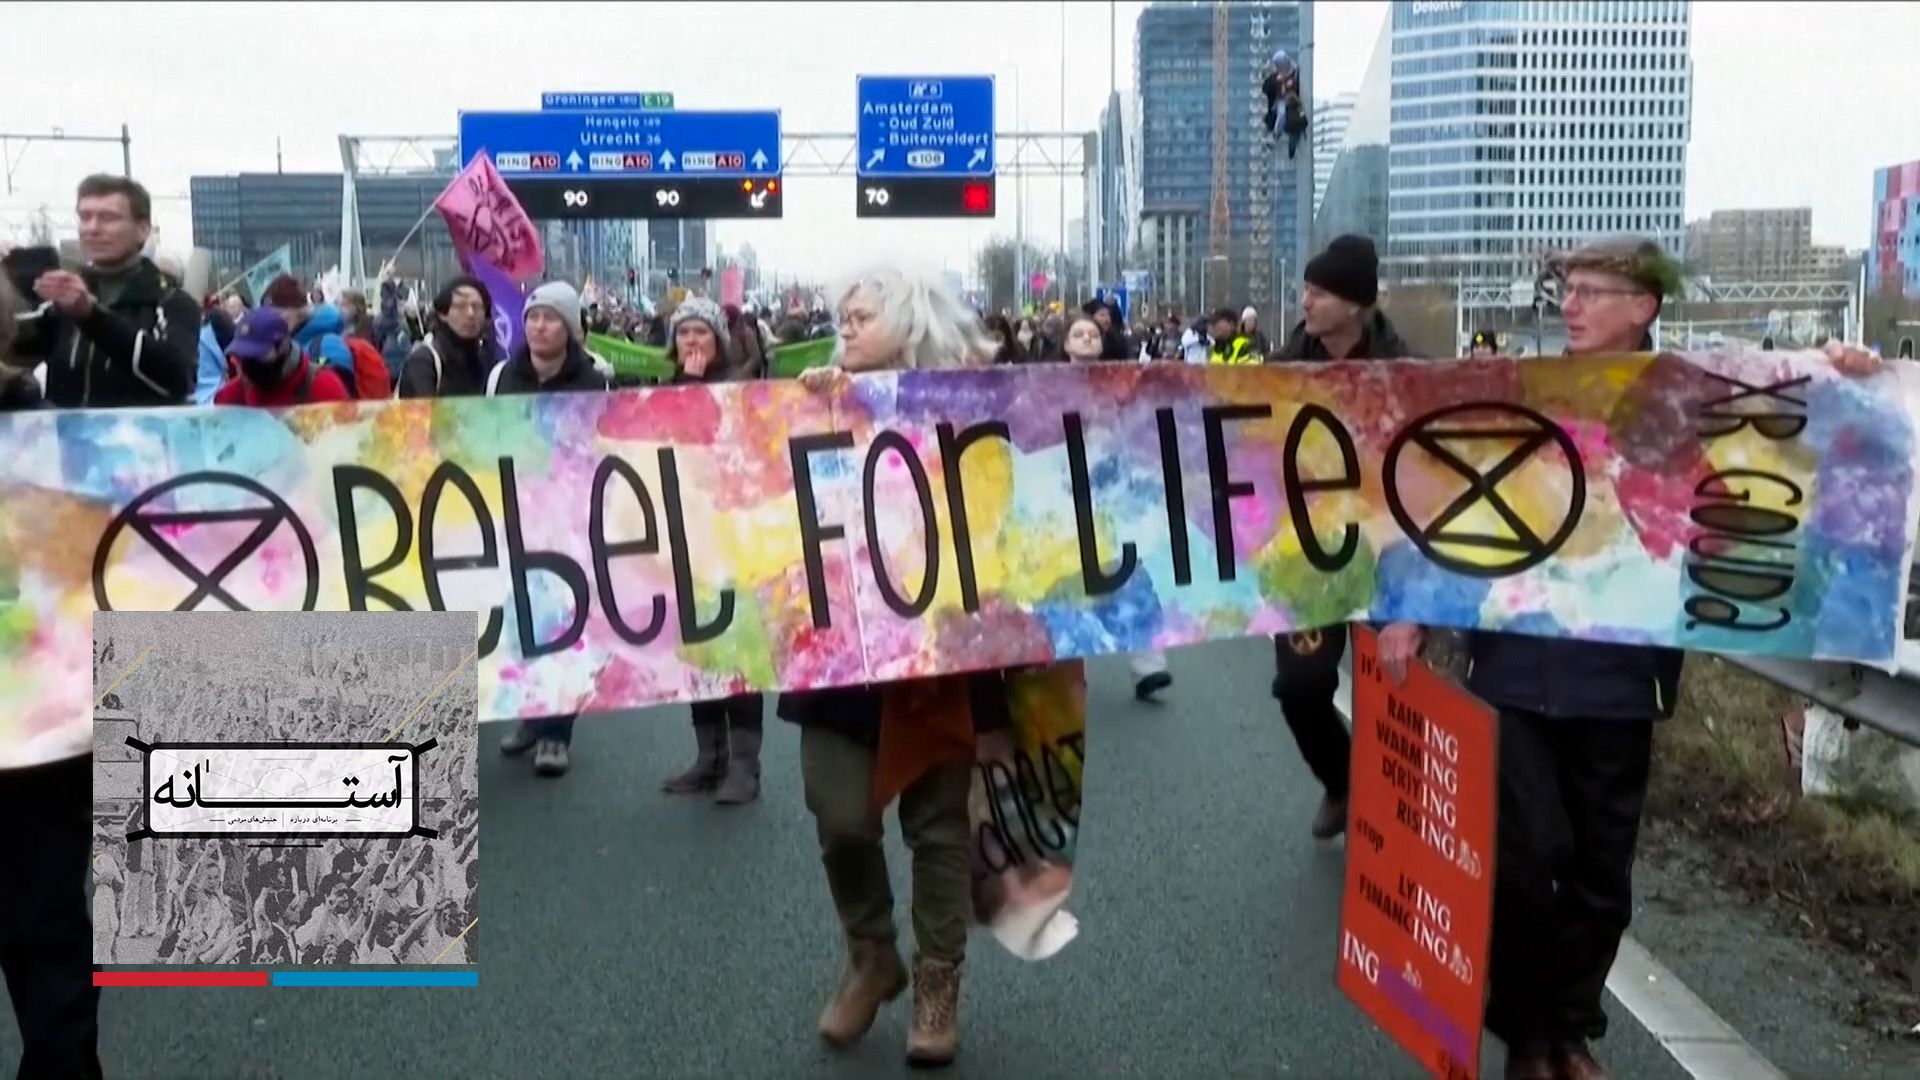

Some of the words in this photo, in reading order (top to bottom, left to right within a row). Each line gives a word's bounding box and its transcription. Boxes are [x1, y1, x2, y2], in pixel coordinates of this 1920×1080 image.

[545, 94, 616, 108] Groningen
[863, 101, 953, 115] Amsterdam
[585, 115, 640, 130] Hengelo
[889, 117, 918, 130] Oud
[922, 117, 955, 130] Zuid
[580, 132, 640, 146] Utrecht
[889, 132, 989, 146] Buitenveldert
[498, 156, 528, 167] RING
[532, 155, 557, 168] A10
[591, 156, 622, 167] RING
[625, 155, 650, 168] A10
[684, 155, 714, 166] RING
[717, 155, 742, 167] A10
[563, 189, 588, 207] 90
[656, 189, 680, 206] 90
[864, 188, 889, 205] 70
[1696, 374, 1812, 440] XR
[1387, 692, 1459, 763] RAINING
[1376, 719, 1458, 796] WARMING
[1396, 797, 1455, 861] RISING
[1398, 871, 1451, 933] LYING
[1360, 873, 1448, 965] FINANCING
[1343, 929, 1380, 985] ING
